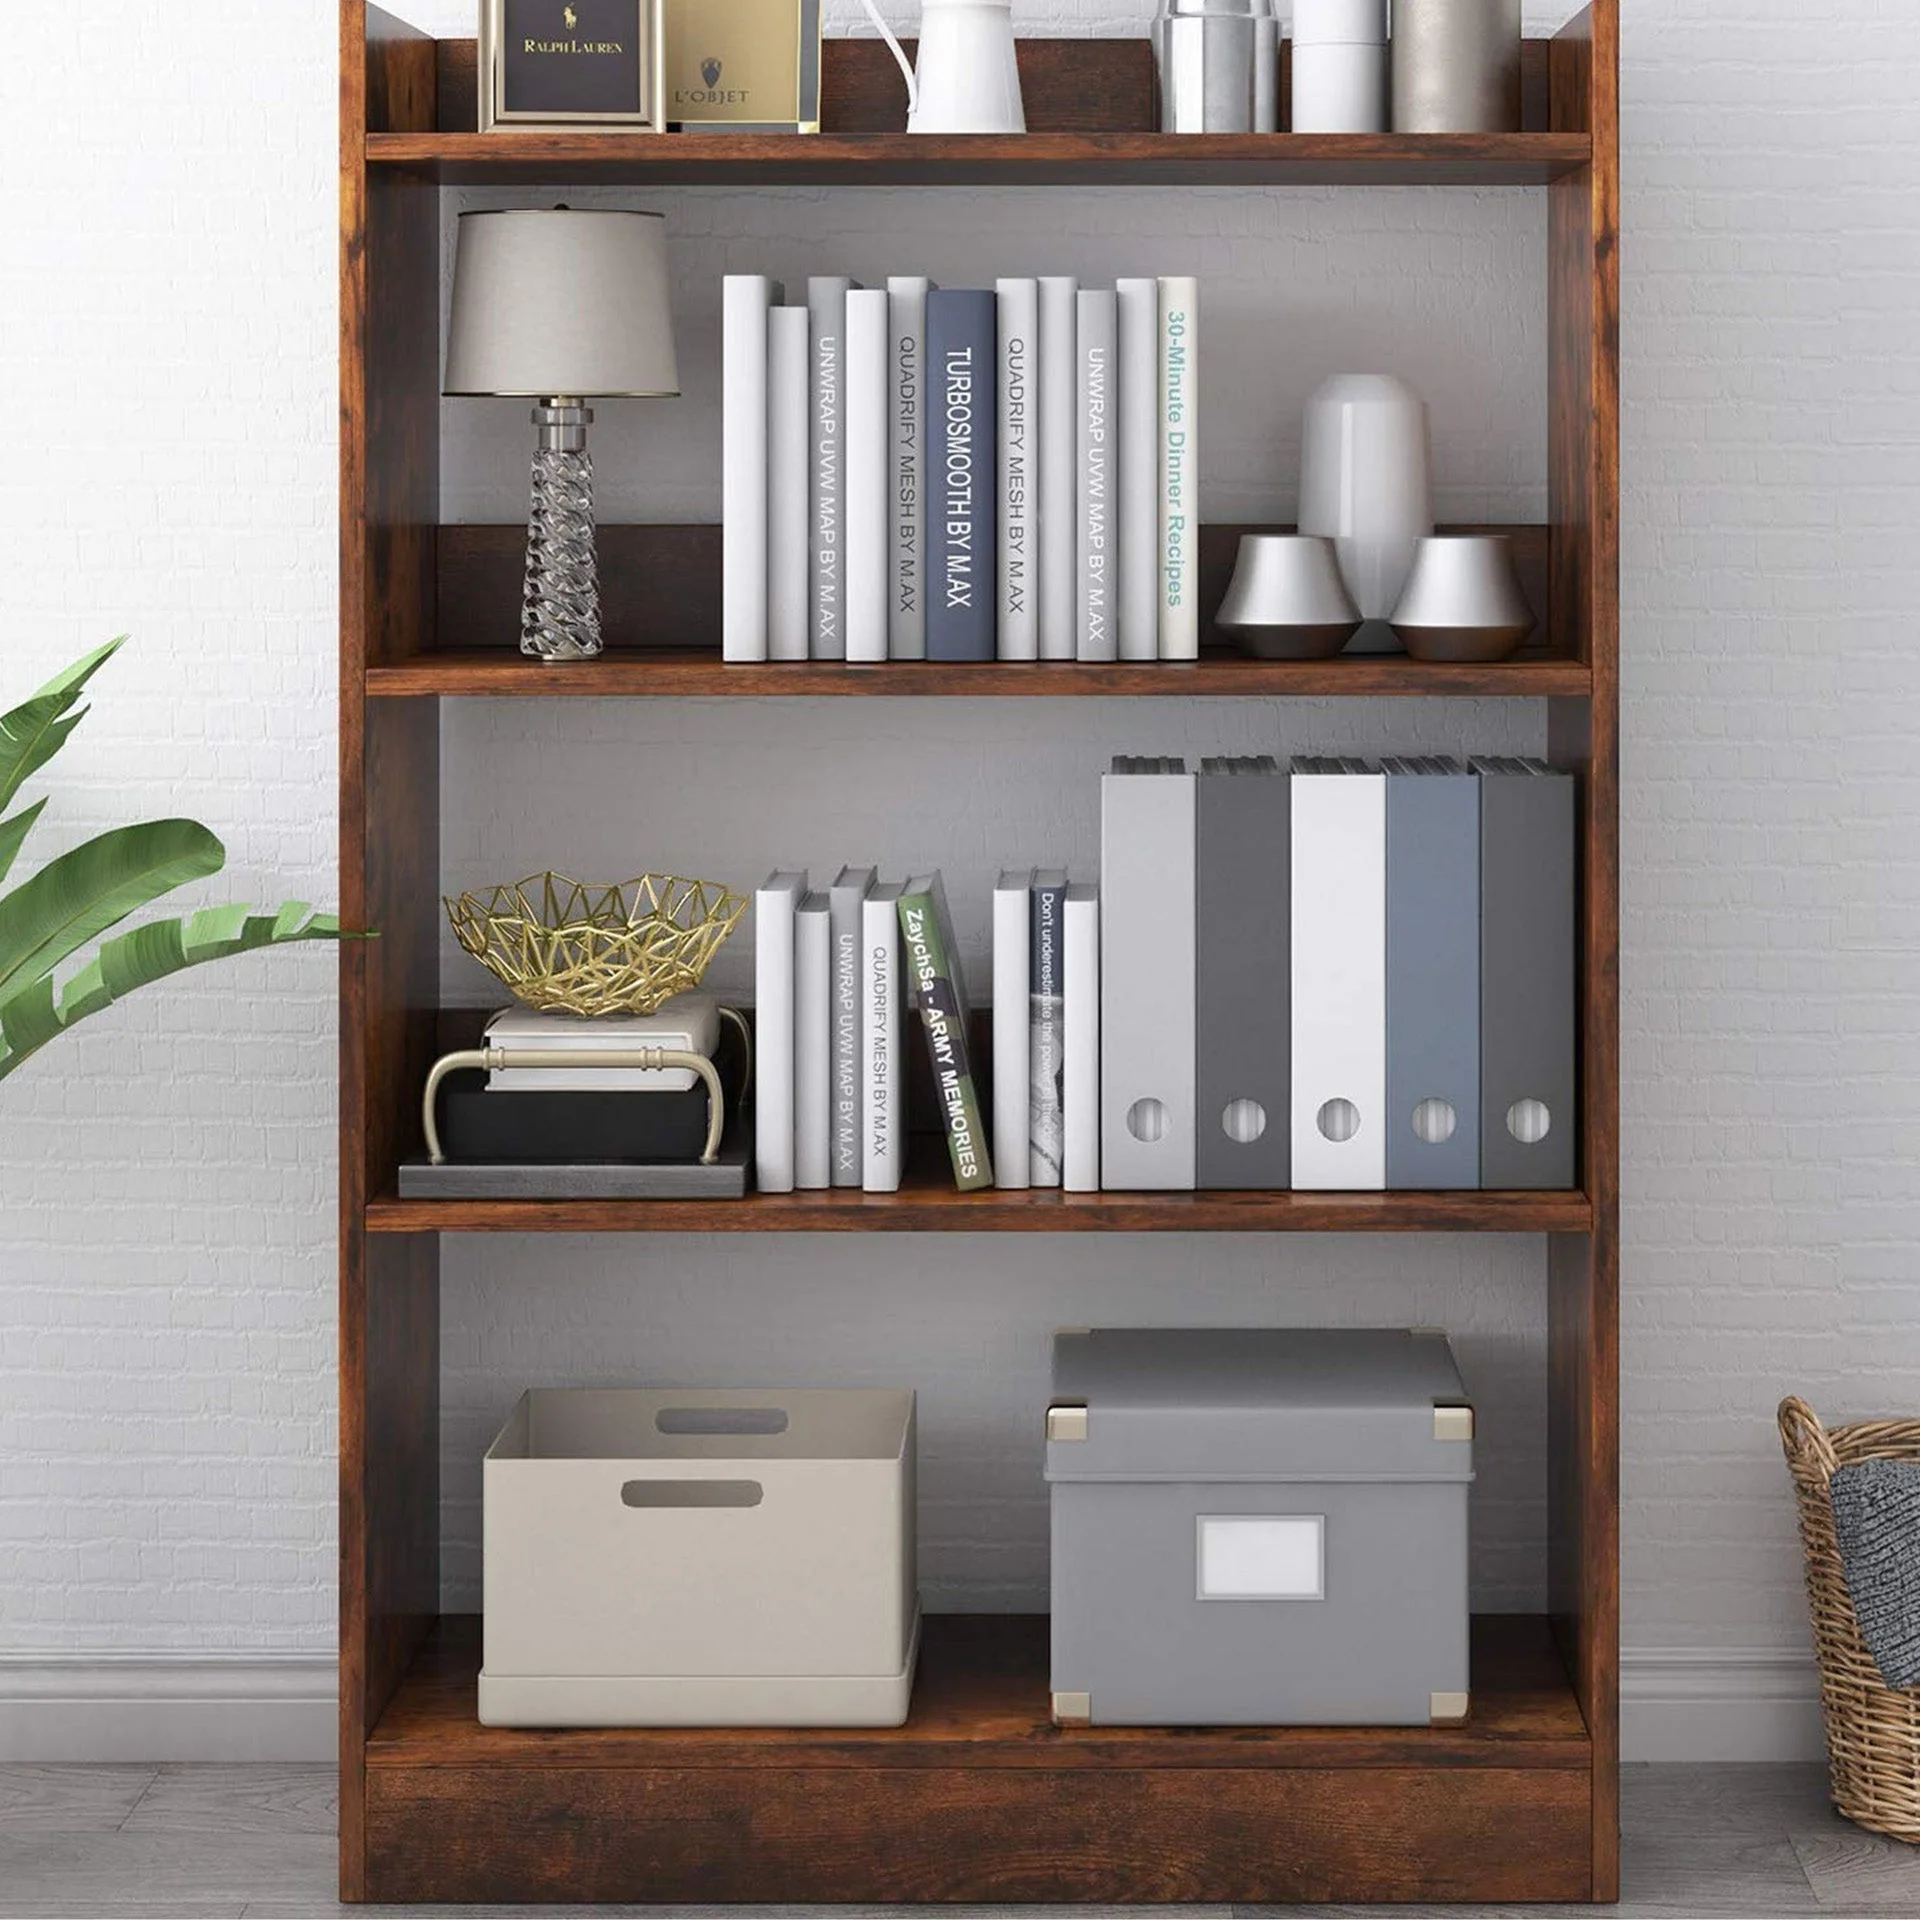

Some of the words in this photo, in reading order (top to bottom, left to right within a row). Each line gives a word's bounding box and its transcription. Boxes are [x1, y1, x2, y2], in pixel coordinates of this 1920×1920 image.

[674, 90, 750, 104] L'OBJET
[819, 336, 836, 433] UNWRAP
[1167, 311, 1185, 423] 30-Minute
[899, 336, 916, 449] QUADRIFY
[1008, 338, 1025, 451] QUADRIFY
[1088, 347, 1105, 442] UNWRAP
[946, 347, 972, 514] TURBOSMOOTH
[819, 440, 836, 490] UVW
[899, 456, 916, 517] MESH
[1008, 457, 1025, 519] MESH
[1088, 449, 1105, 497] UVW
[1167, 432, 1185, 507] Dinner
[819, 497, 836, 543] MAP
[899, 526, 916, 553] BY
[946, 521, 972, 548] BY
[1008, 527, 1025, 554] BY
[1088, 504, 1105, 548] MAP
[819, 550, 836, 578] BY
[946, 555, 972, 608] M.AX
[1088, 555, 1105, 583] BY
[1162, 515, 1185, 606] Recipes
[819, 584, 836, 638] M.AX
[899, 560, 916, 613] M.AX
[1008, 561, 1025, 613] M.AX
[1088, 588, 1105, 641] M.AX
[1042, 893, 1054, 926] Don't
[839, 934, 854, 1009] UNWRAP
[873, 947, 887, 1032] QUADRIFY
[839, 1015, 854, 1054] UVW
[1042, 1022, 1053, 1041] the
[839, 1060, 854, 1095] MAP
[873, 1037, 887, 1084] MESH
[839, 1101, 854, 1122] BY
[873, 1090, 887, 1111] BY
[926, 1008, 954, 1064] ARMY
[940, 1070, 978, 1179] MEMORIES
[839, 1128, 854, 1170] M.AX
[873, 1116, 887, 1157] M.AX
